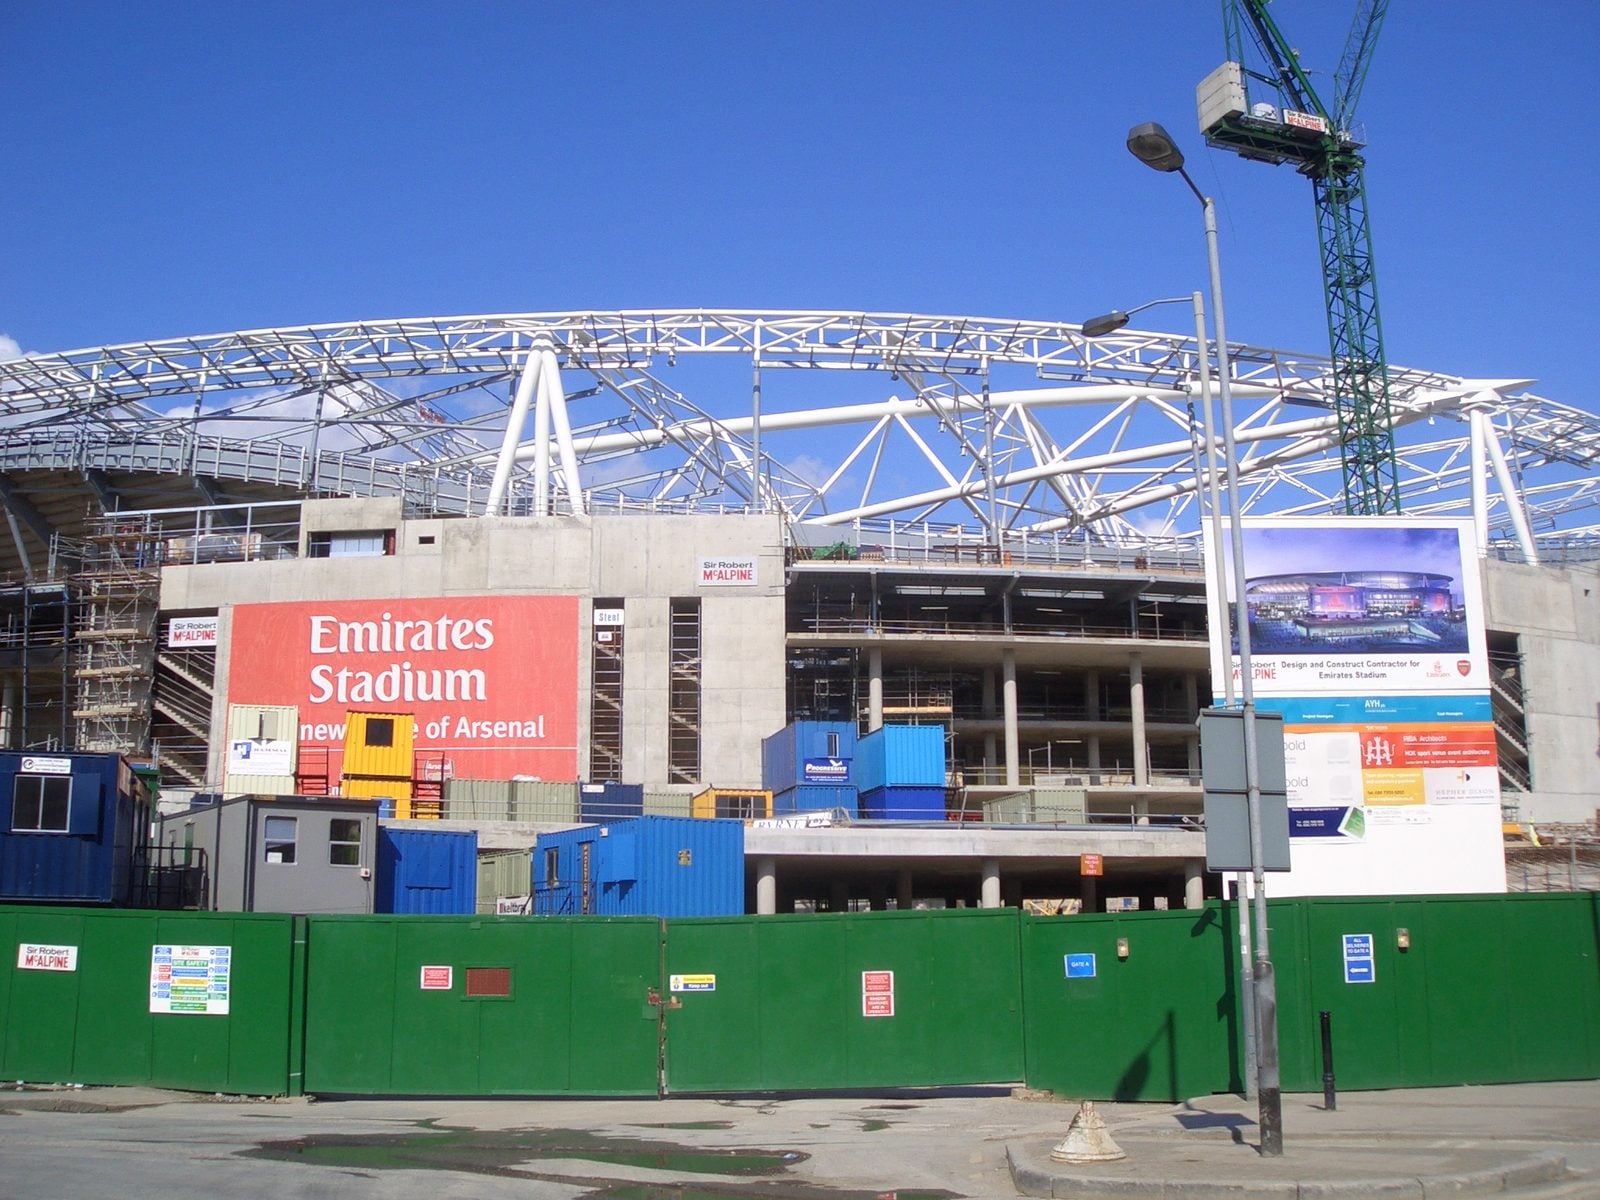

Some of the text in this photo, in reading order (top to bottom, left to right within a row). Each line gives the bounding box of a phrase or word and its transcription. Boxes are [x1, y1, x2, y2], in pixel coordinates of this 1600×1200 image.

[703, 561, 753, 569] Sir Robert
[703, 570, 753, 581] McALPINE
[187, 622, 217, 630] Robert
[173, 630, 217, 641] McALPINE
[310, 612, 494, 654] Emirates
[1250, 661, 1276, 669] obert
[1281, 661, 1307, 669] Design
[1326, 660, 1364, 668] Construct
[1366, 660, 1408, 668] Contractor
[1231, 669, 1277, 679] McLPINE
[1319, 671, 1353, 679] Emirates
[309, 660, 488, 704] Stadium
[1364, 699, 1380, 708] AYH
[300, 723, 347, 741] new
[425, 716, 450, 739] of
[454, 715, 546, 739] Arsenal
[26, 946, 70, 956] Sir Robert
[25, 955, 69, 968] McALPINE
